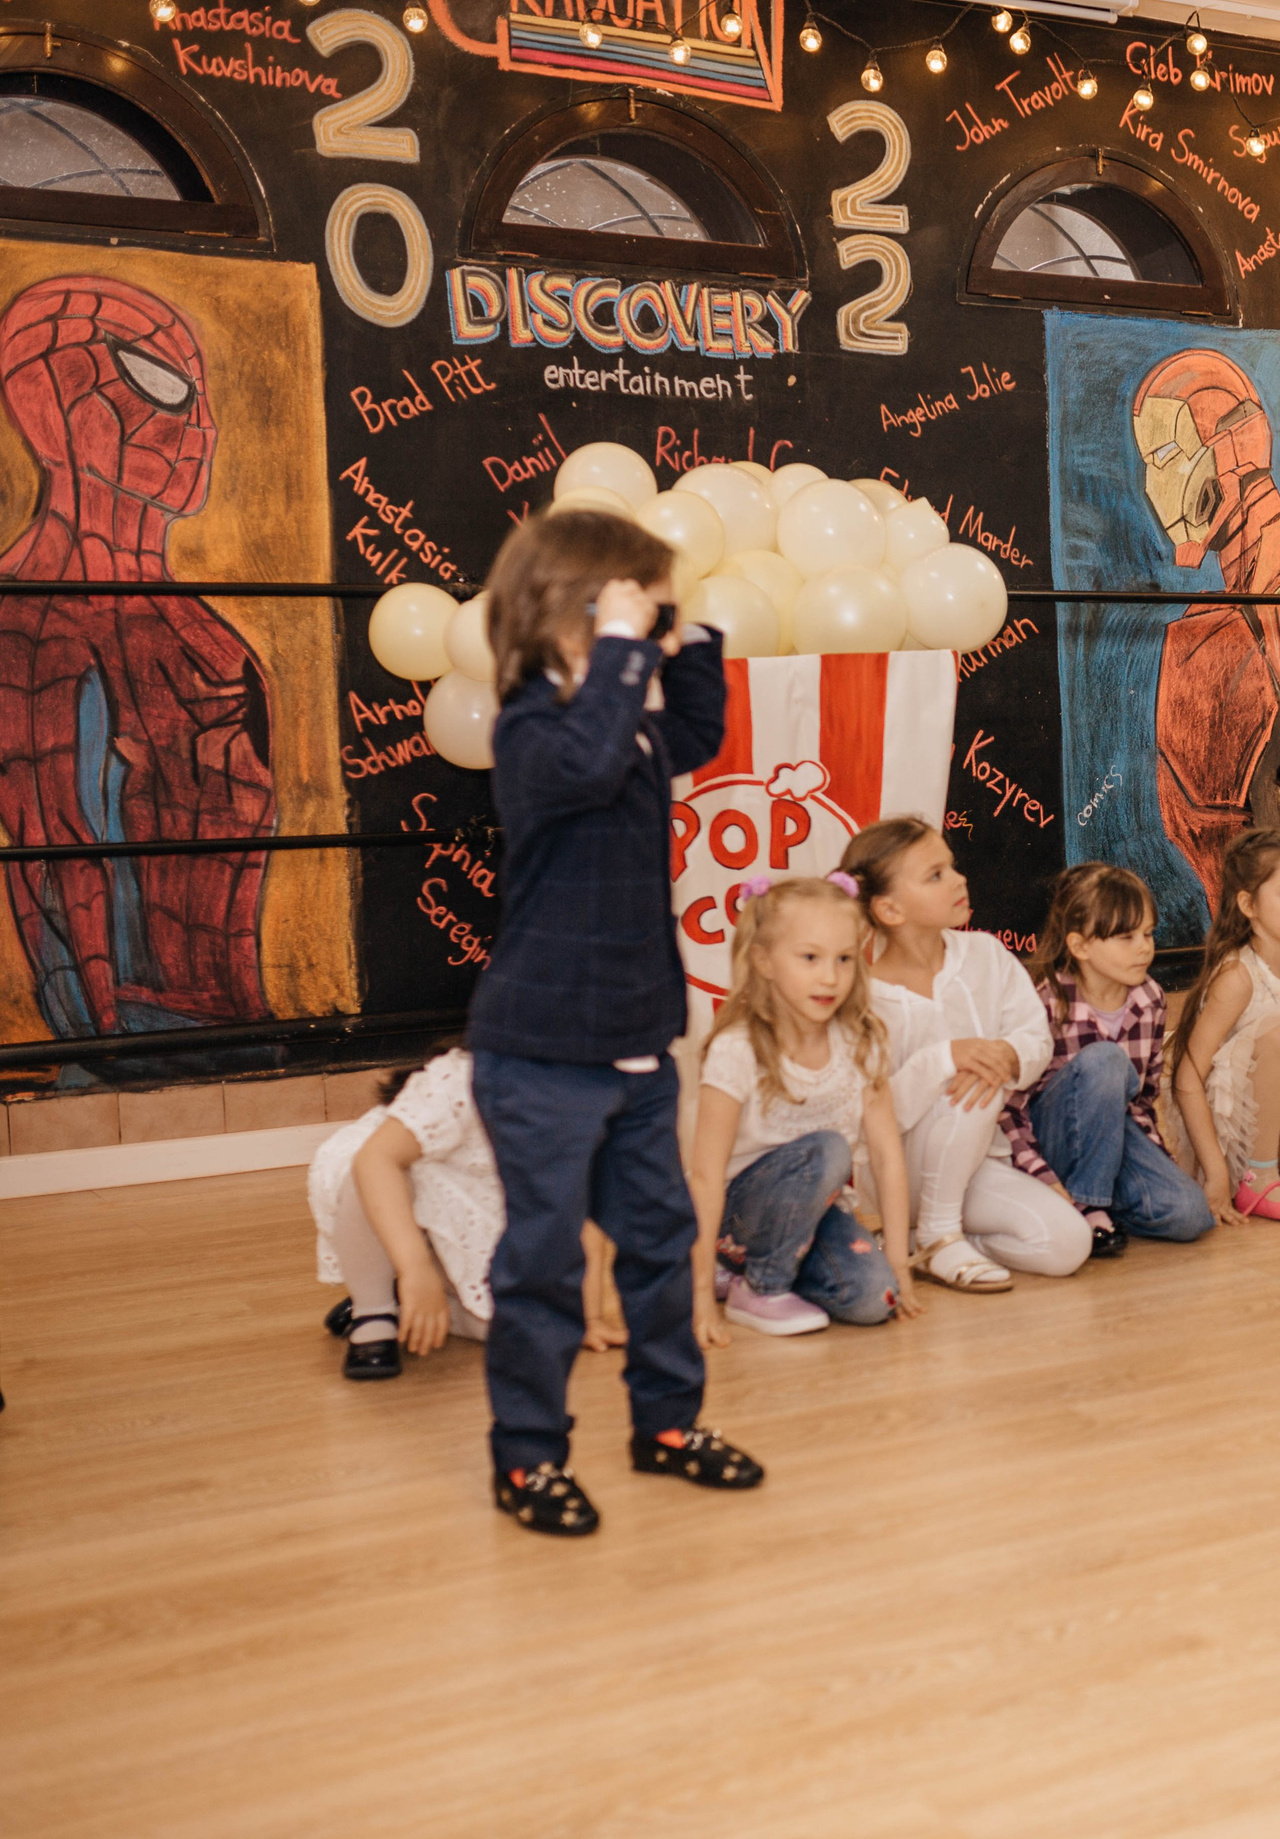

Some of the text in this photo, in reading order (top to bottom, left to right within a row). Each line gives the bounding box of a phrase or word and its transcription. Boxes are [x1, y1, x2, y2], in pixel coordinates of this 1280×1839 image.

[945, 51, 1098, 151] John Travolt
[1125, 41, 1183, 86] Gleb
[1118, 97, 1261, 224] Kira Smirnova
[446, 265, 813, 359] DISCOVERY
[350, 354, 497, 434] Brad Pitt
[543, 355, 754, 400] entertainment
[880, 361, 1017, 438] Angelina Jolie
[338, 457, 457, 580] Anastasia
[958, 504, 1034, 569] Marder
[348, 679, 436, 733] Arnol
[962, 729, 1055, 829] Kozyrev
[400, 792, 496, 898] Sphia
[670, 797, 812, 883] POP
